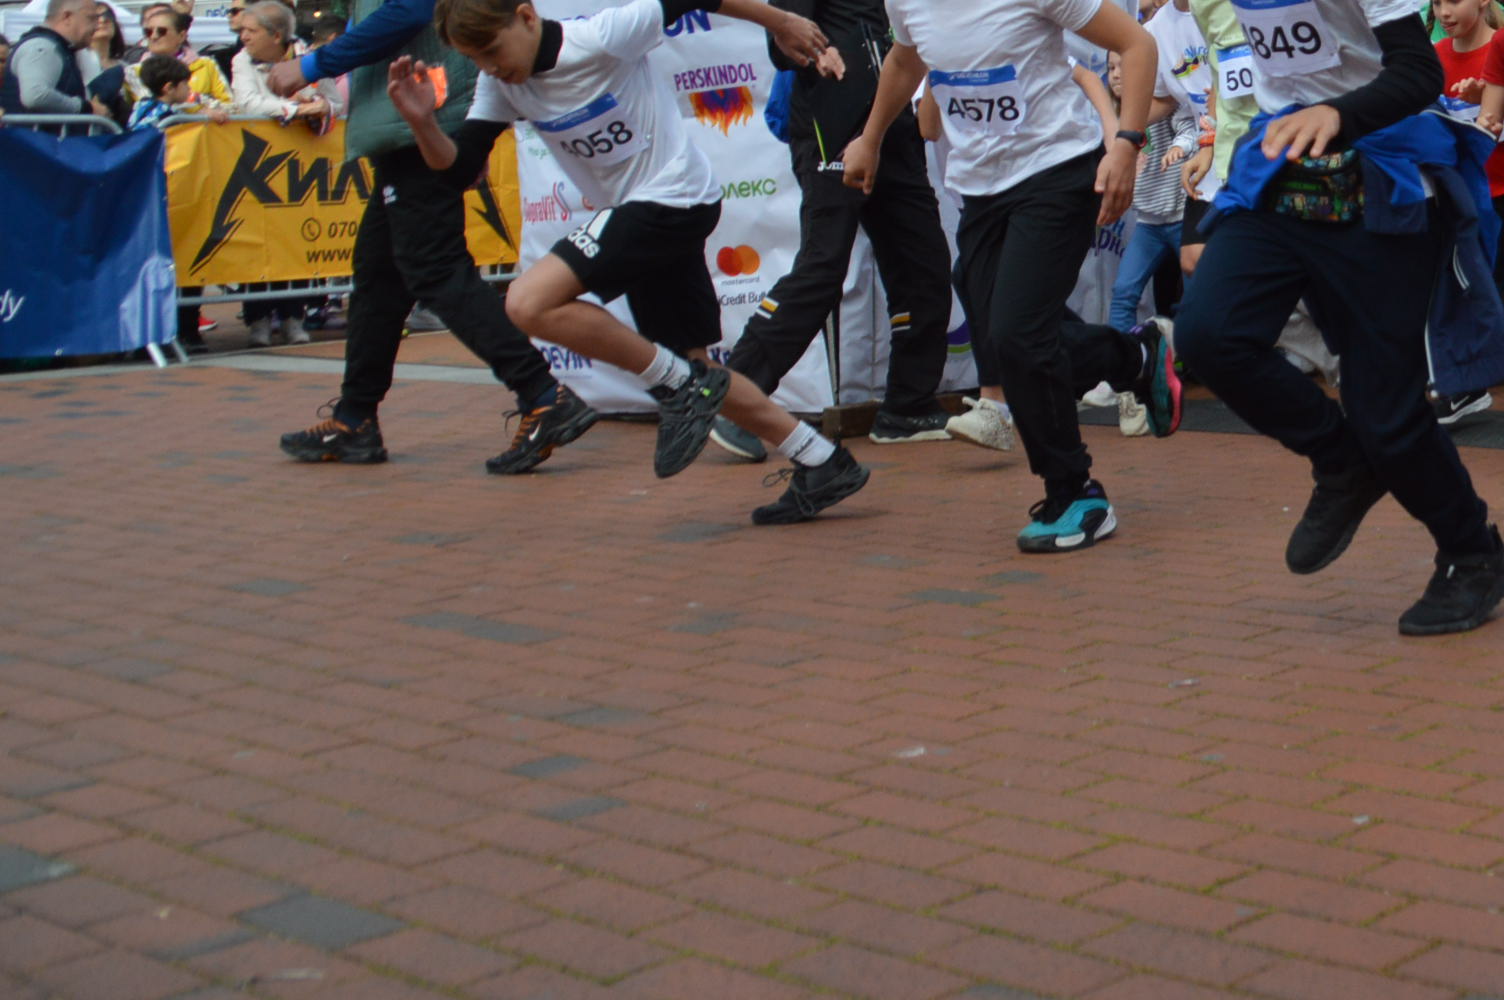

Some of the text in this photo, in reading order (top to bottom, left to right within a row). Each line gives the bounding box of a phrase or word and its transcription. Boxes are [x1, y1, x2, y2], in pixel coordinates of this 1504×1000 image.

[1243, 21, 1321, 60] 849
[674, 63, 757, 91] PERSKINDOL
[948, 96, 1019, 122] 4578
